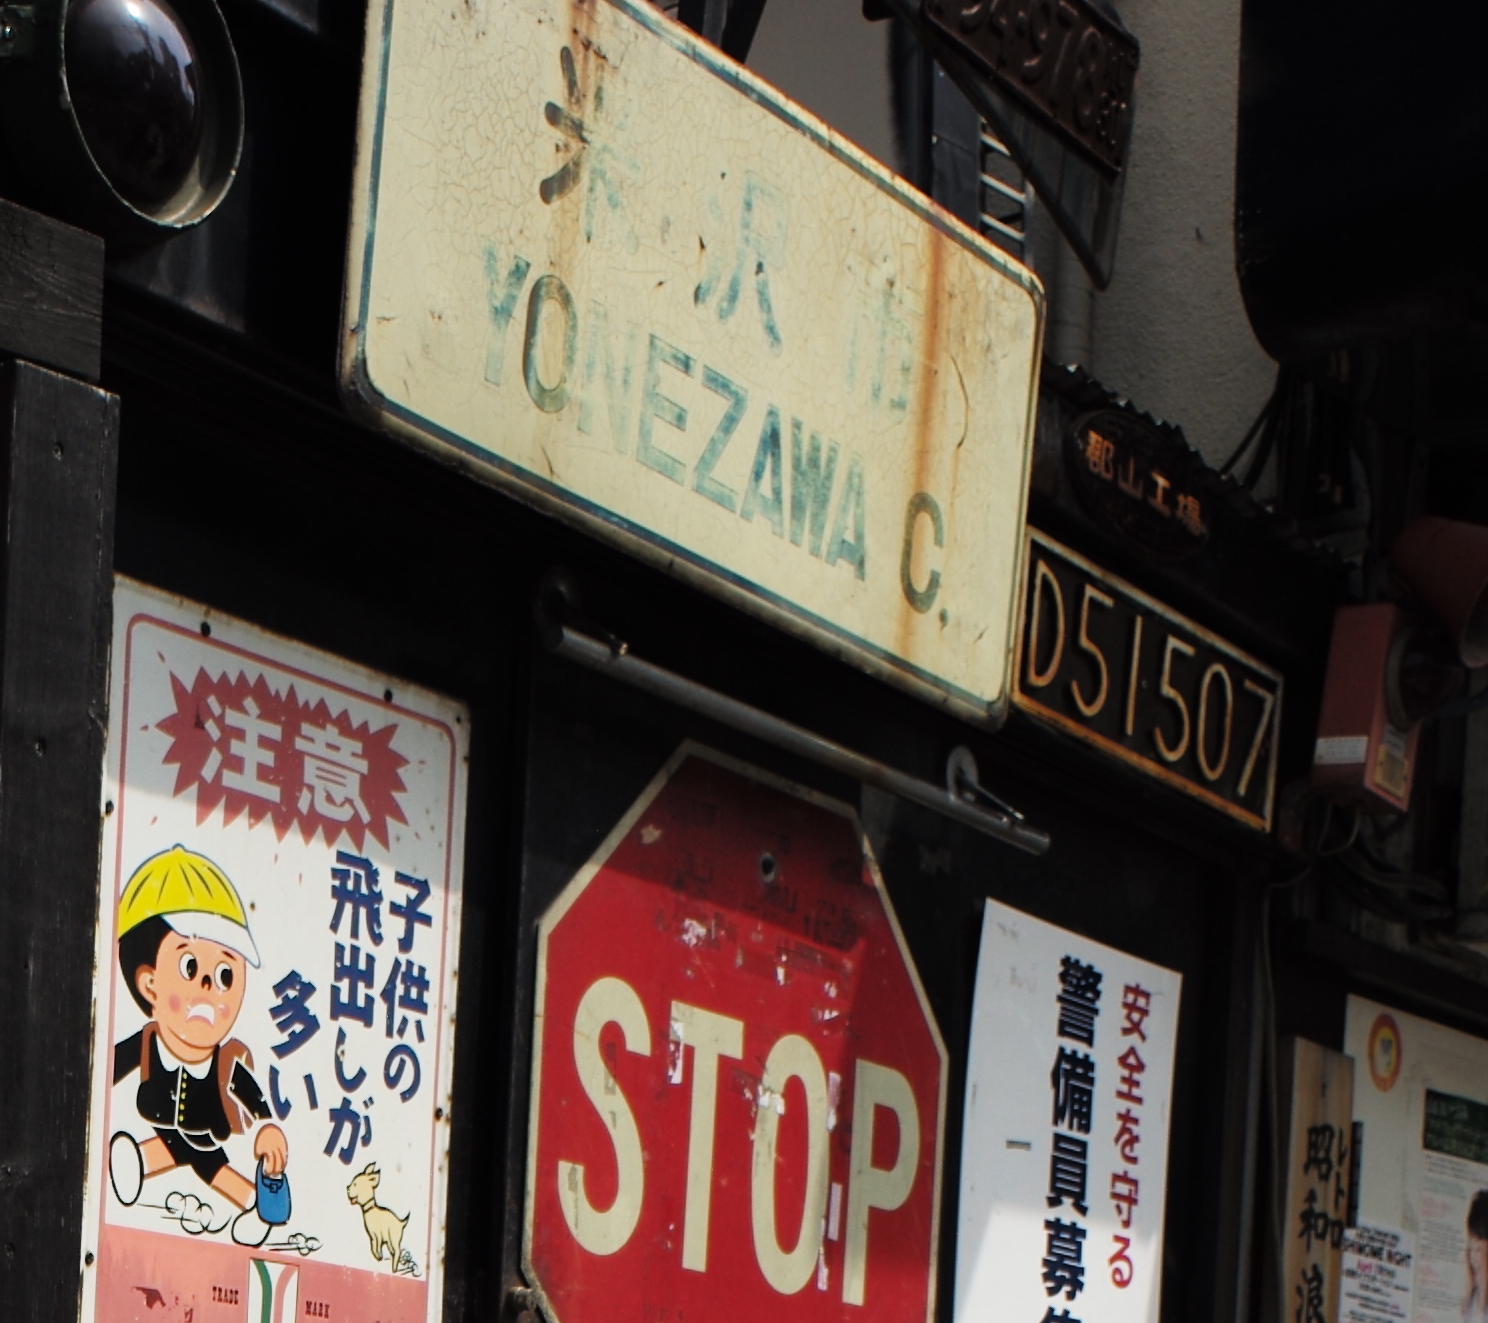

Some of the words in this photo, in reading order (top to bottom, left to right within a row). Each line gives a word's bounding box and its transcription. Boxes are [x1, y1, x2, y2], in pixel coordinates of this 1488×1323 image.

[480, 242, 867, 582] YONEZAWA
[899, 492, 950, 630] C.
[197, 692, 371, 828] 注意
[266, 969, 324, 1124] 多い
[324, 850, 386, 1167] 飛出しが
[379, 871, 435, 1105] 子供の
[557, 977, 921, 1307] STOP
[1106, 982, 1153, 1291] 安全を守る
[211, 1286, 240, 1307] TRADE
[304, 1300, 331, 1320] MARK
